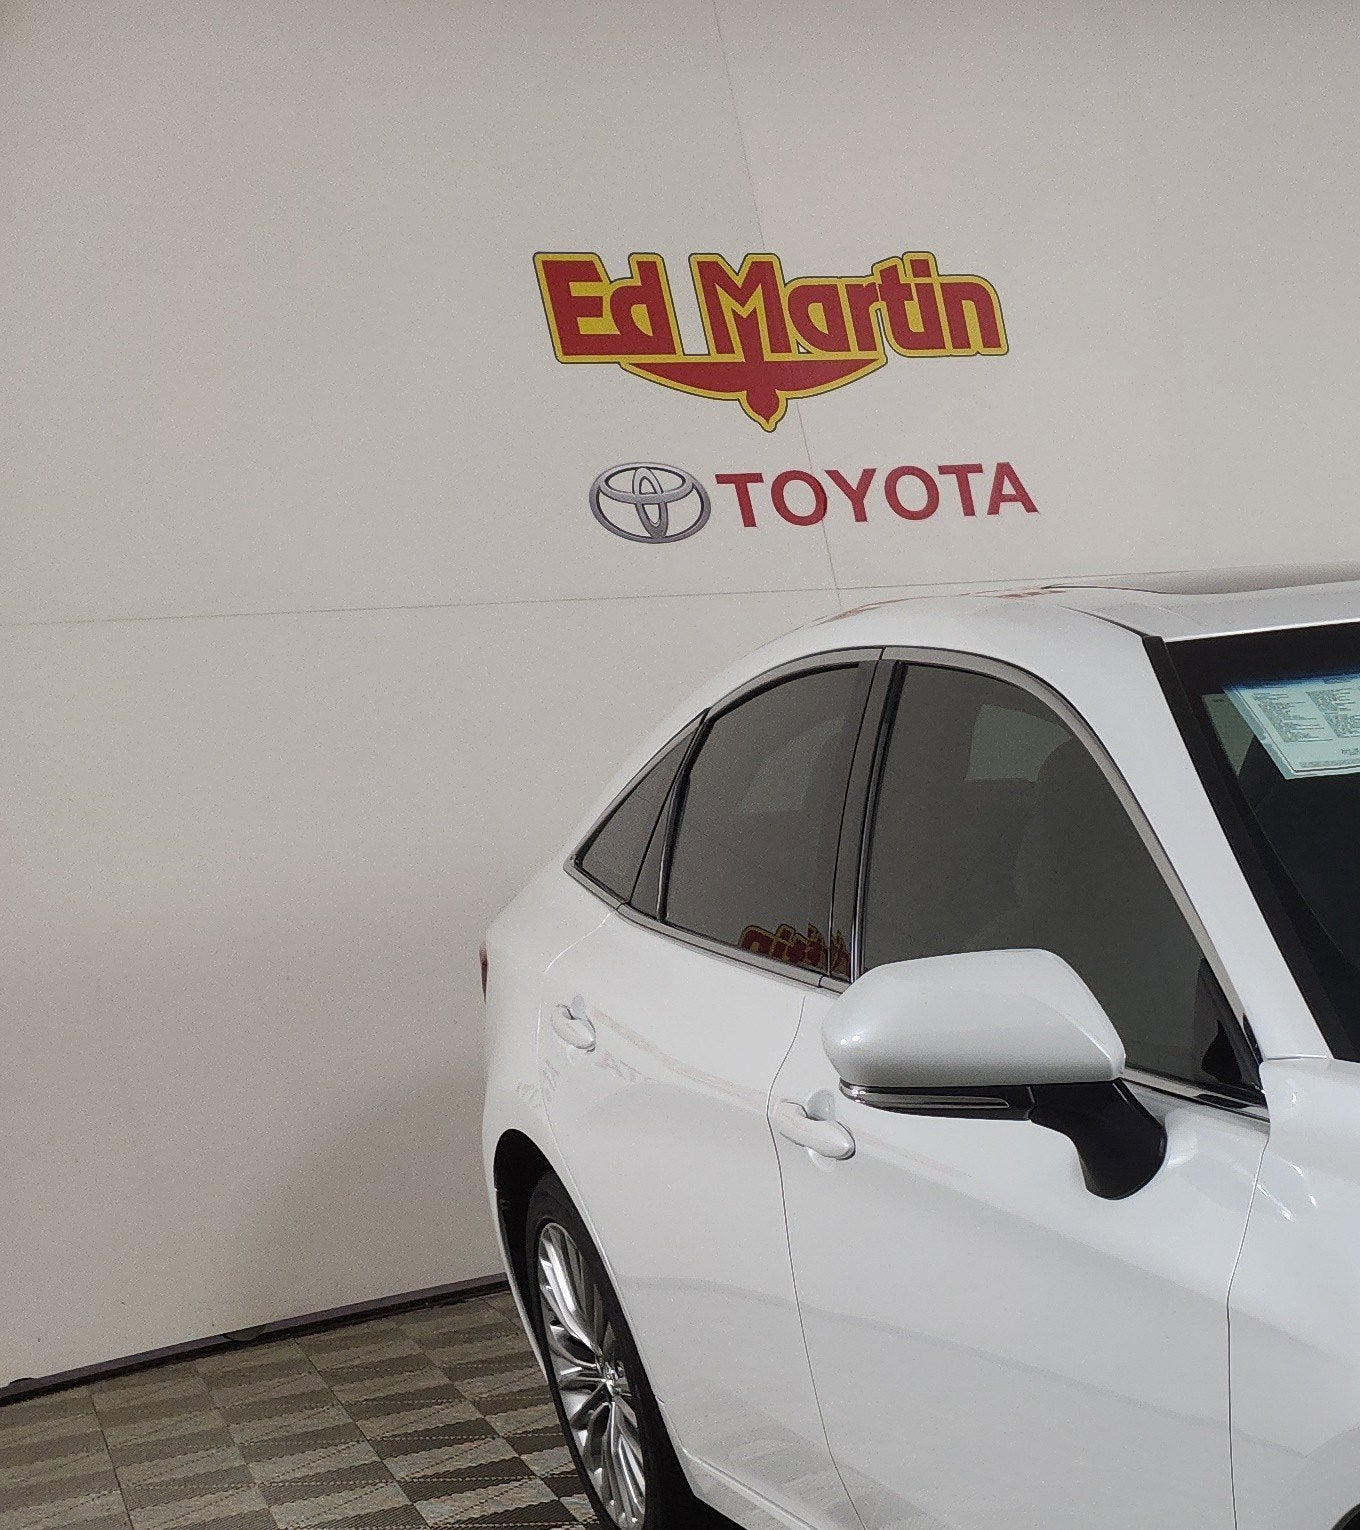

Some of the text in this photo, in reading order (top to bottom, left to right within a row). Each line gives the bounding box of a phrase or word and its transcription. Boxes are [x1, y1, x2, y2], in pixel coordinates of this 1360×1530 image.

[538, 254, 1006, 359] Ed Martin
[715, 462, 1038, 527] TOYOTA
